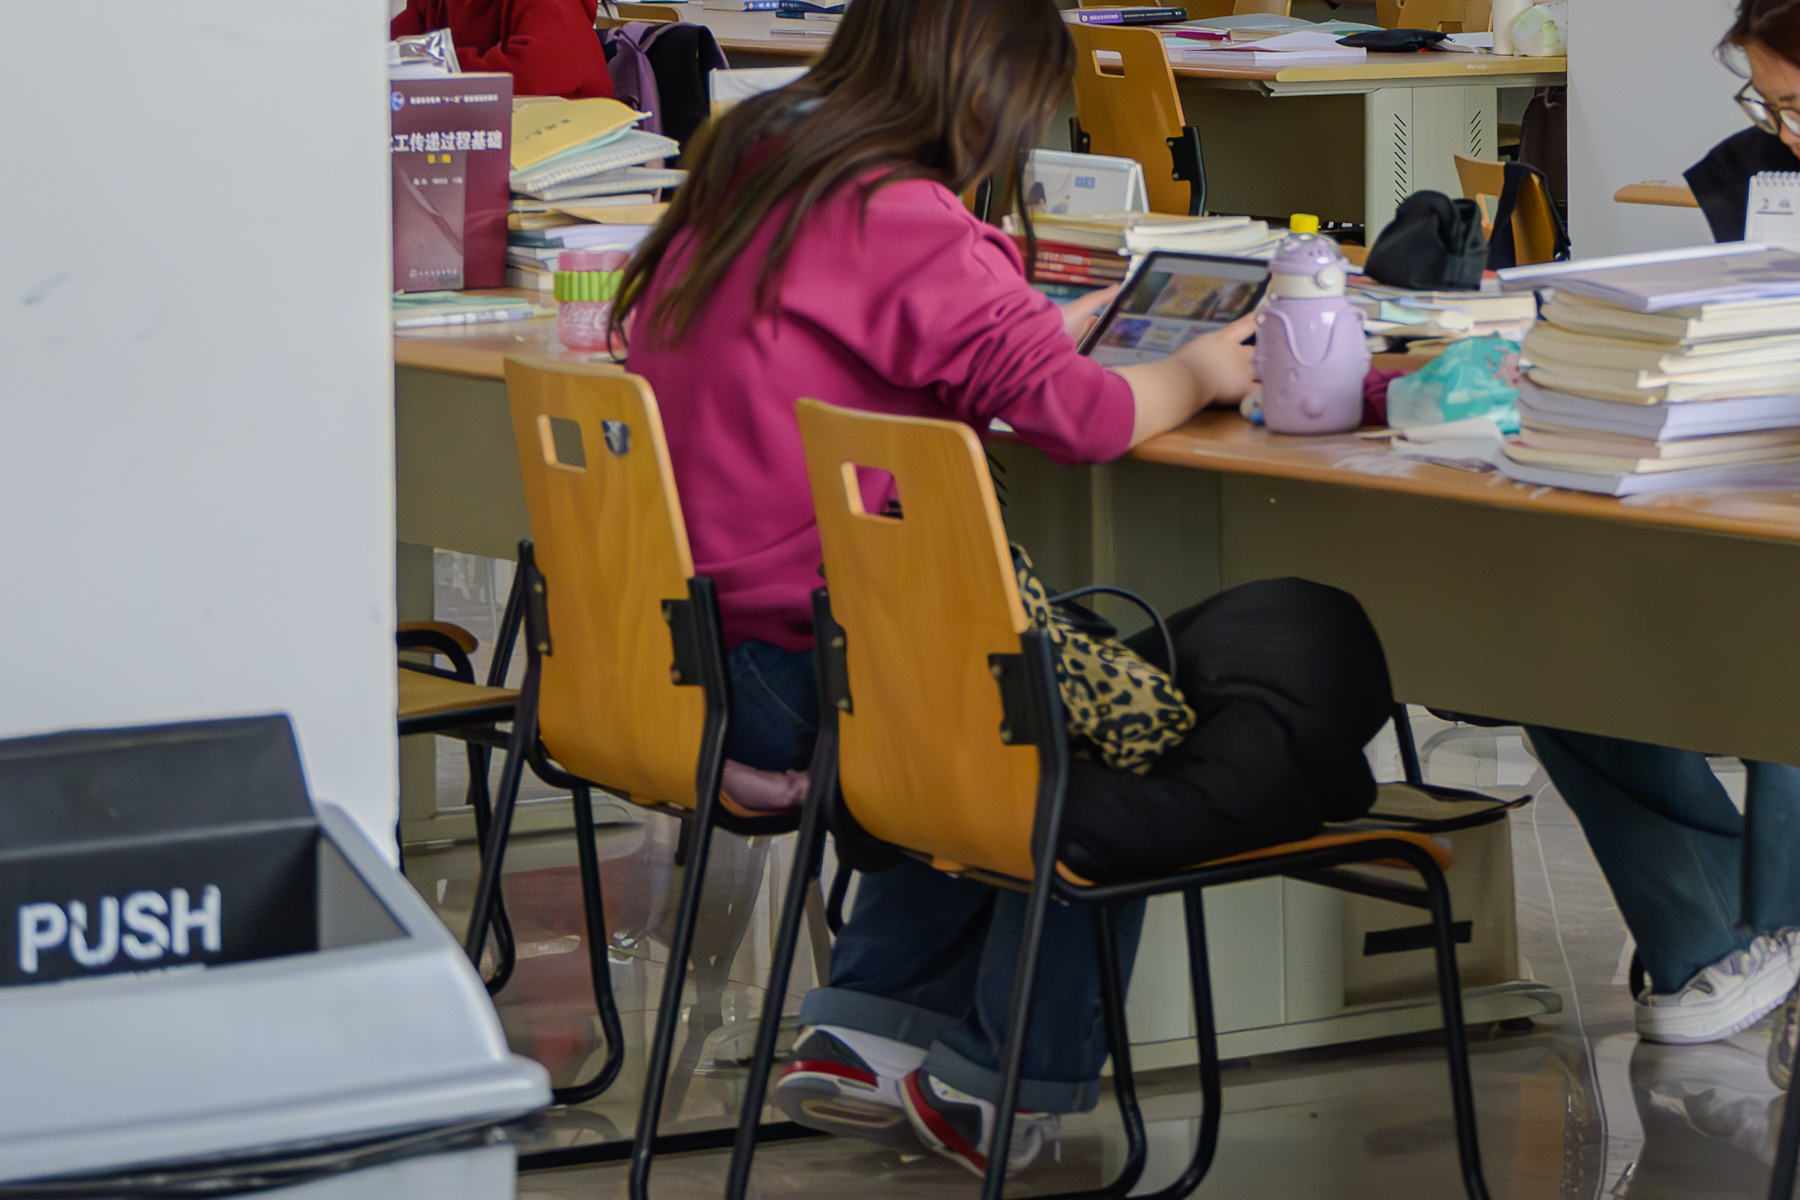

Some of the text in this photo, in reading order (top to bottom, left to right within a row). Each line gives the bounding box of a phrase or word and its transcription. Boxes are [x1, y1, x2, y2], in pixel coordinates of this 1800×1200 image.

[390, 130, 502, 153] 工传递过程基础
[17, 882, 222, 974] PUSH
